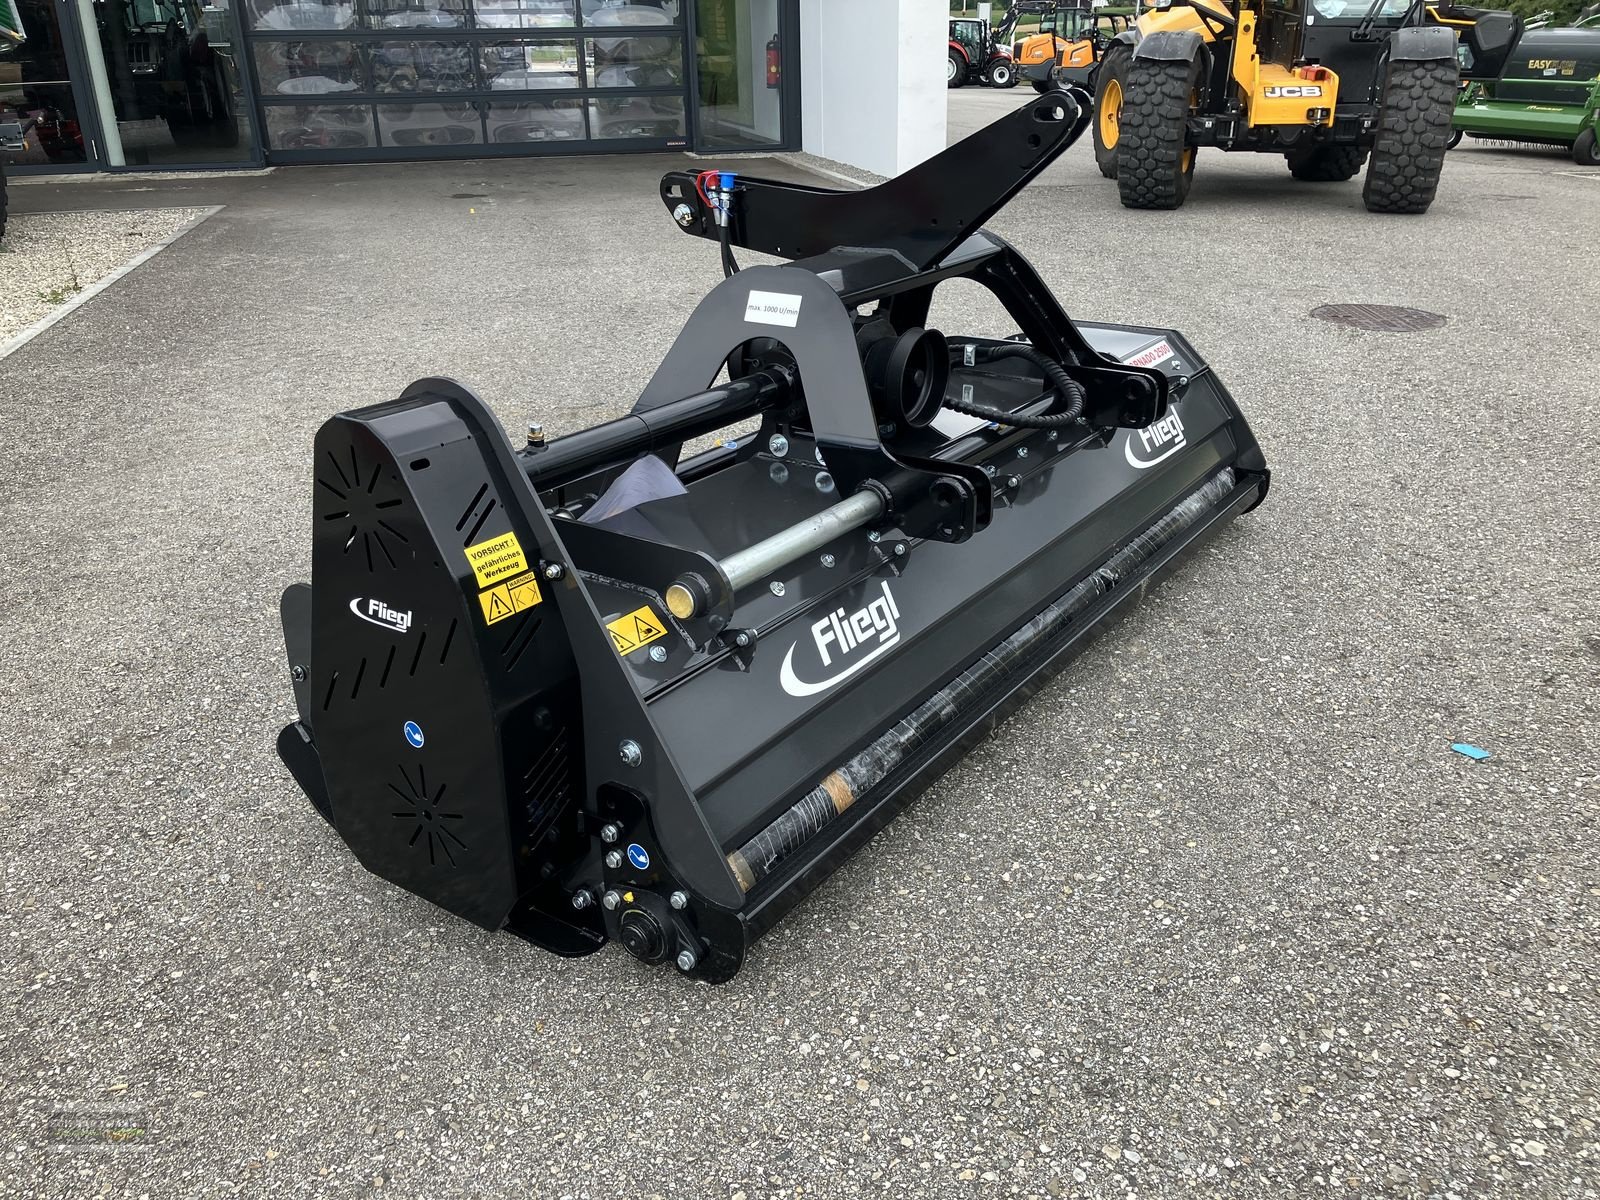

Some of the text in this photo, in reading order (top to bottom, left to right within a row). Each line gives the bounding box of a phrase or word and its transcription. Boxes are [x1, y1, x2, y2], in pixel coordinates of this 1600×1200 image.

[1264, 86, 1321, 97] JCB
[763, 305, 778, 313] 1000
[779, 306, 799, 315] U/min
[1153, 344, 1171, 359] 2500
[471, 540, 509, 560] VORSICHT
[477, 550, 521, 573] gefährliches
[484, 561, 520, 579] Werkzeug
[509, 574, 534, 587] WARNING!
[368, 599, 413, 630] Fliegl
[811, 580, 900, 667] Fliegl
